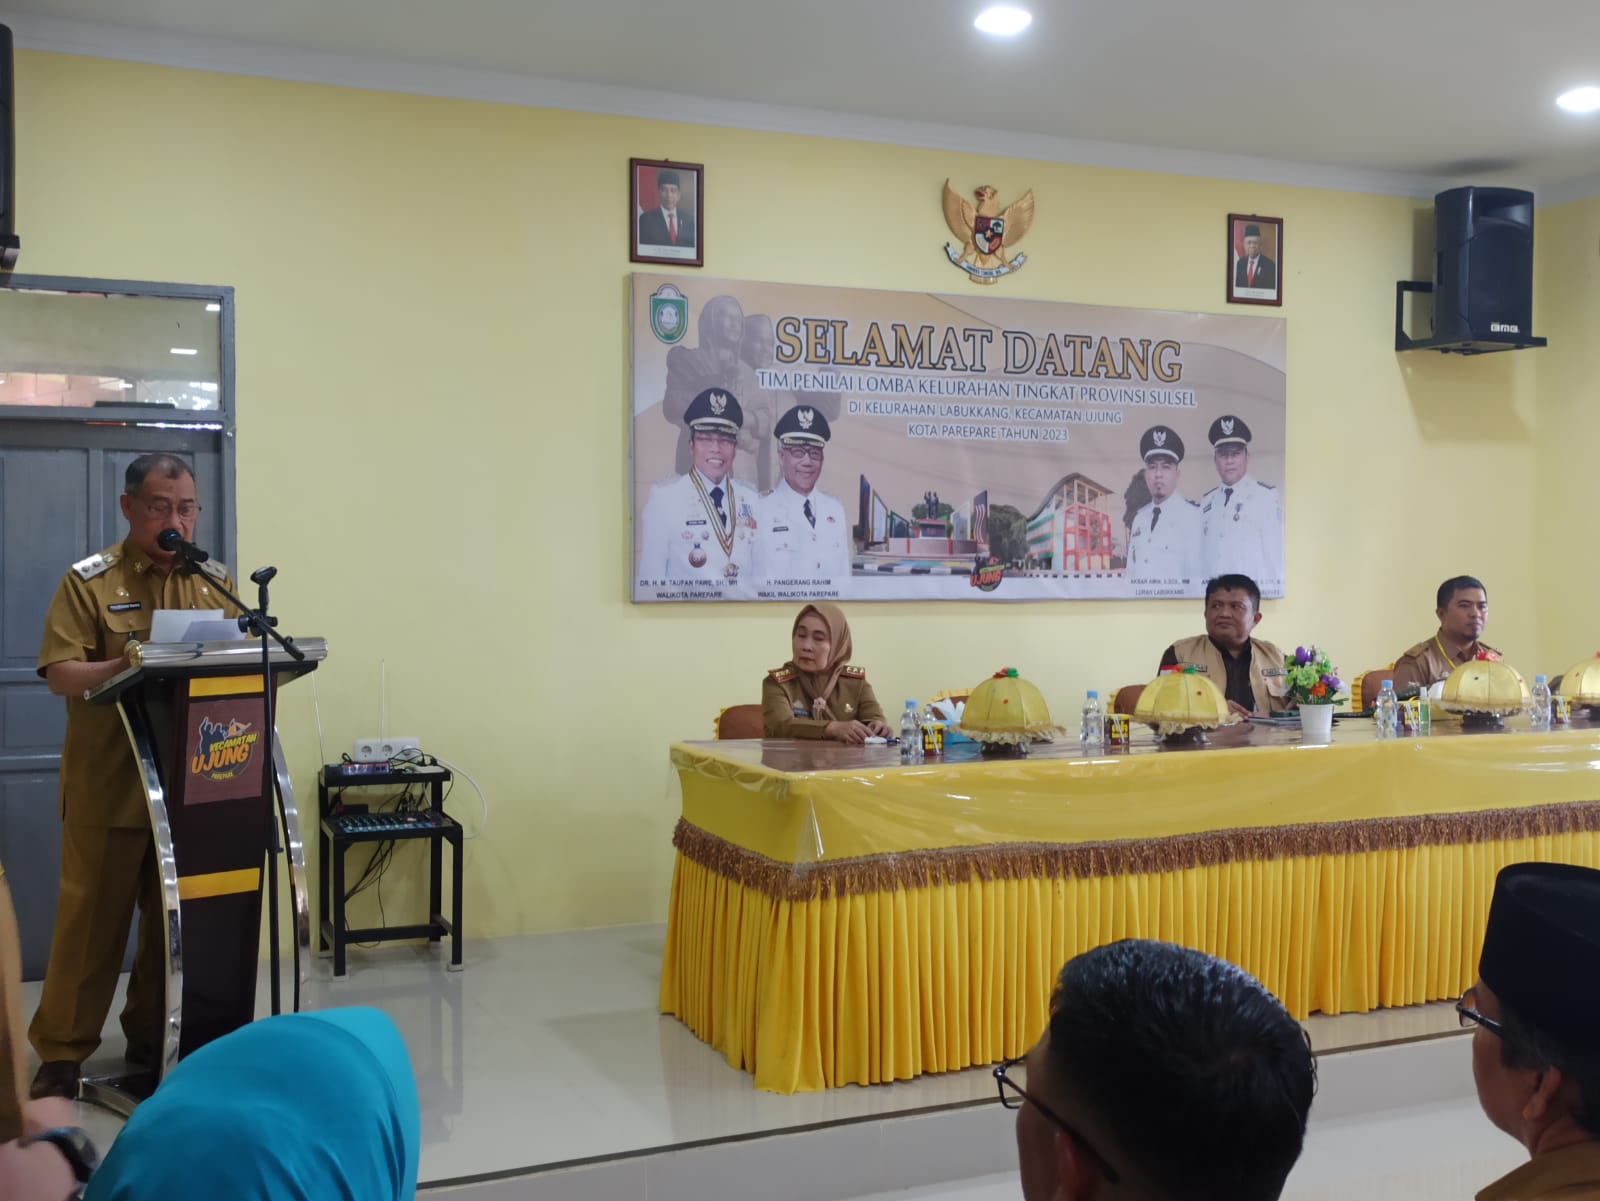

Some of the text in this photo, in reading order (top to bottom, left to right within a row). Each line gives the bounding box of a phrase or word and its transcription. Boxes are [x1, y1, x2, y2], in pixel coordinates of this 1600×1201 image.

[775, 316, 1183, 383] SELAMAT DATANG
[759, 371, 1196, 406] TIM PENILAI LOMBA KELURAHAN TINGKAT PROVINSI SULSEL
[849, 400, 860, 413] DI
[866, 401, 936, 415] KELURAHAN
[1015, 408, 1082, 422] KECAMATAN
[1086, 411, 1122, 424] UJUNG
[908, 424, 1068, 441] KOTA PAREPARE TAHUN 2023
[191, 743, 250, 774] UJUNG
